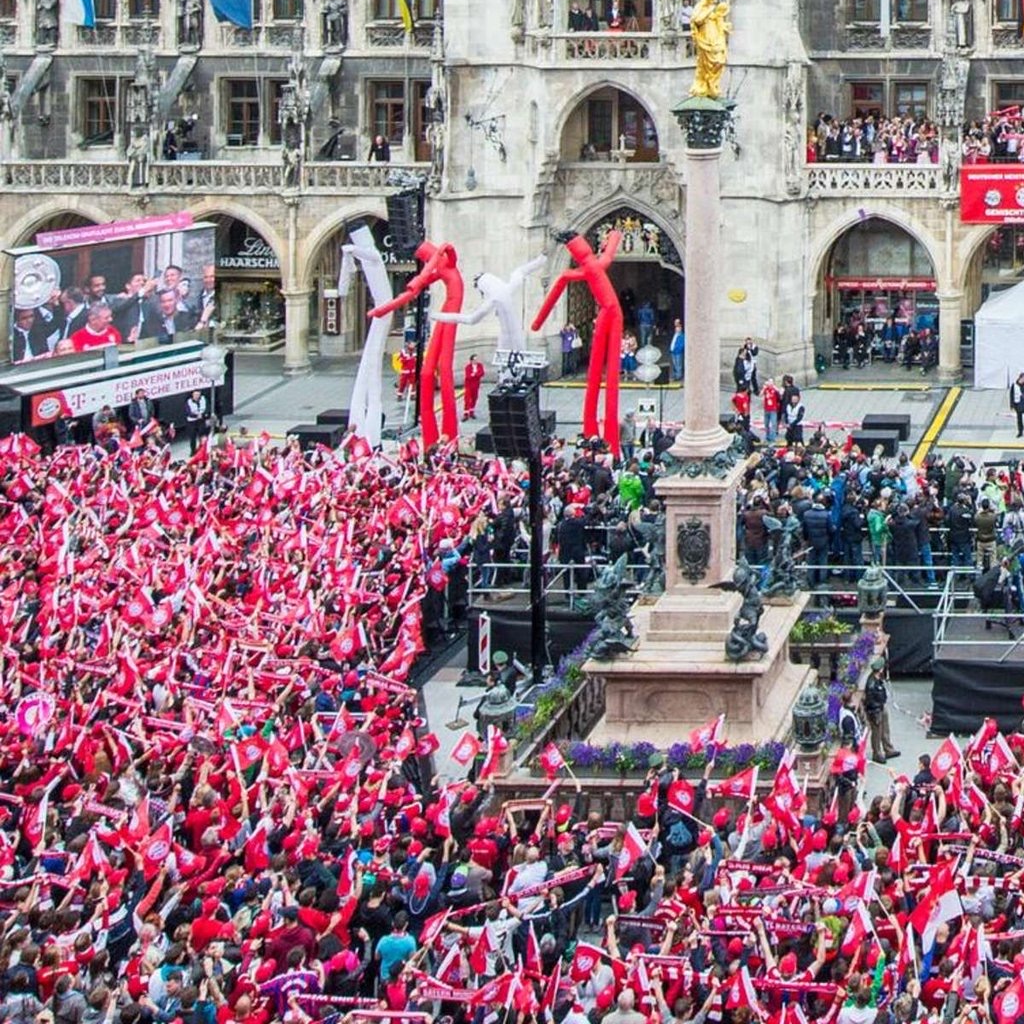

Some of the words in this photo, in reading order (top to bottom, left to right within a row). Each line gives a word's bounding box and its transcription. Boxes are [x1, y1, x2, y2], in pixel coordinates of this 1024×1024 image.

[115, 380, 129, 391] FC
[130, 372, 171, 388] BAYERN
[115, 385, 170, 403] DESCHE
